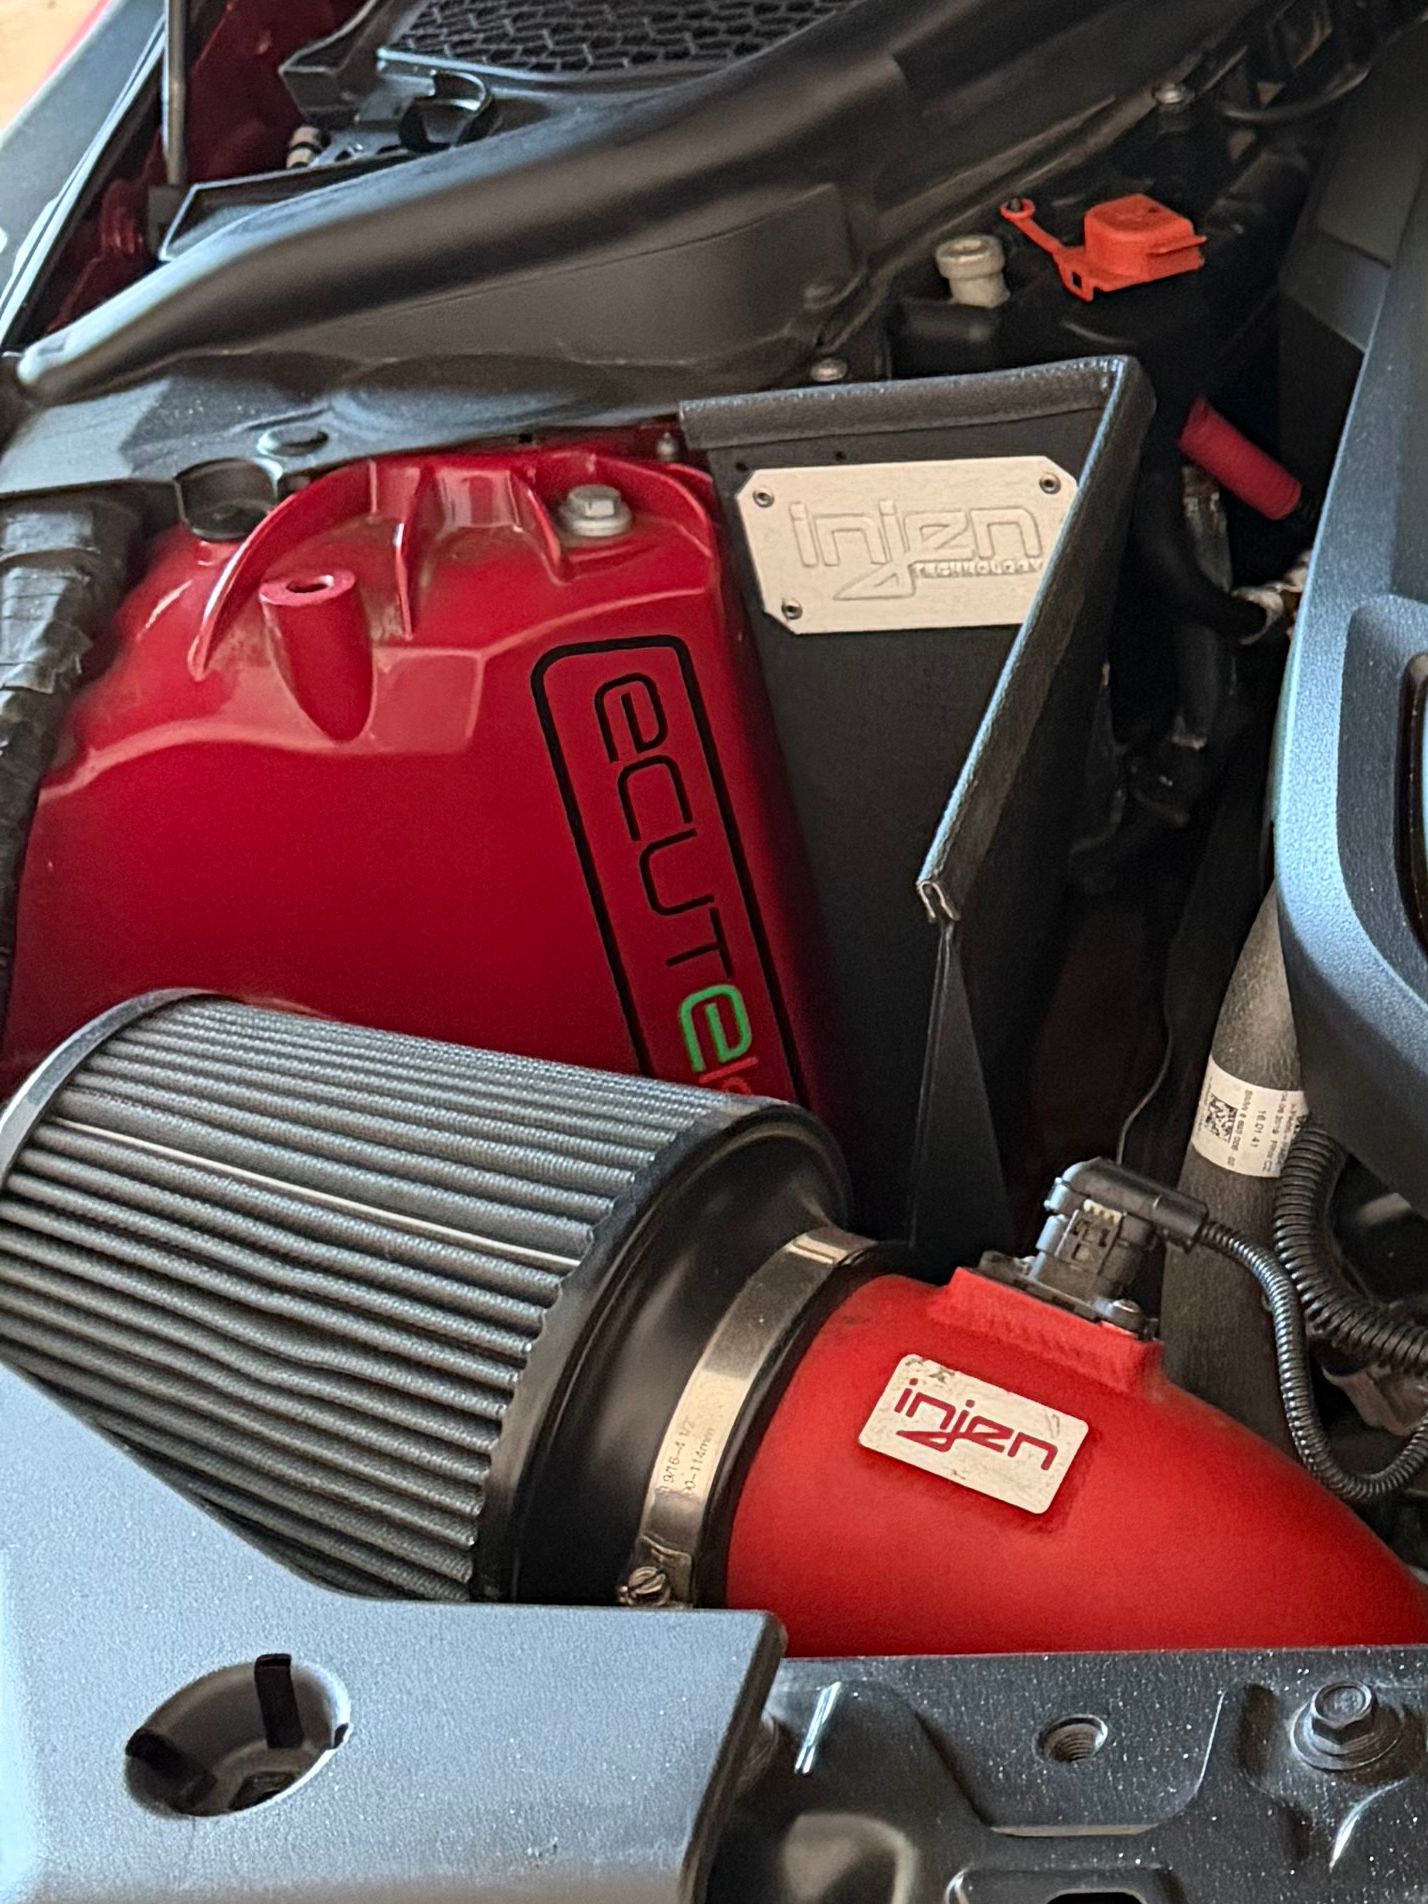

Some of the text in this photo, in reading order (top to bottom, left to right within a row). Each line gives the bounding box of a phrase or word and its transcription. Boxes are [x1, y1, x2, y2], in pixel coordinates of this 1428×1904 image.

[787, 499, 1043, 601] injen
[913, 558, 1044, 579] TECHNOLOGY
[893, 1377, 1059, 1471] injen
